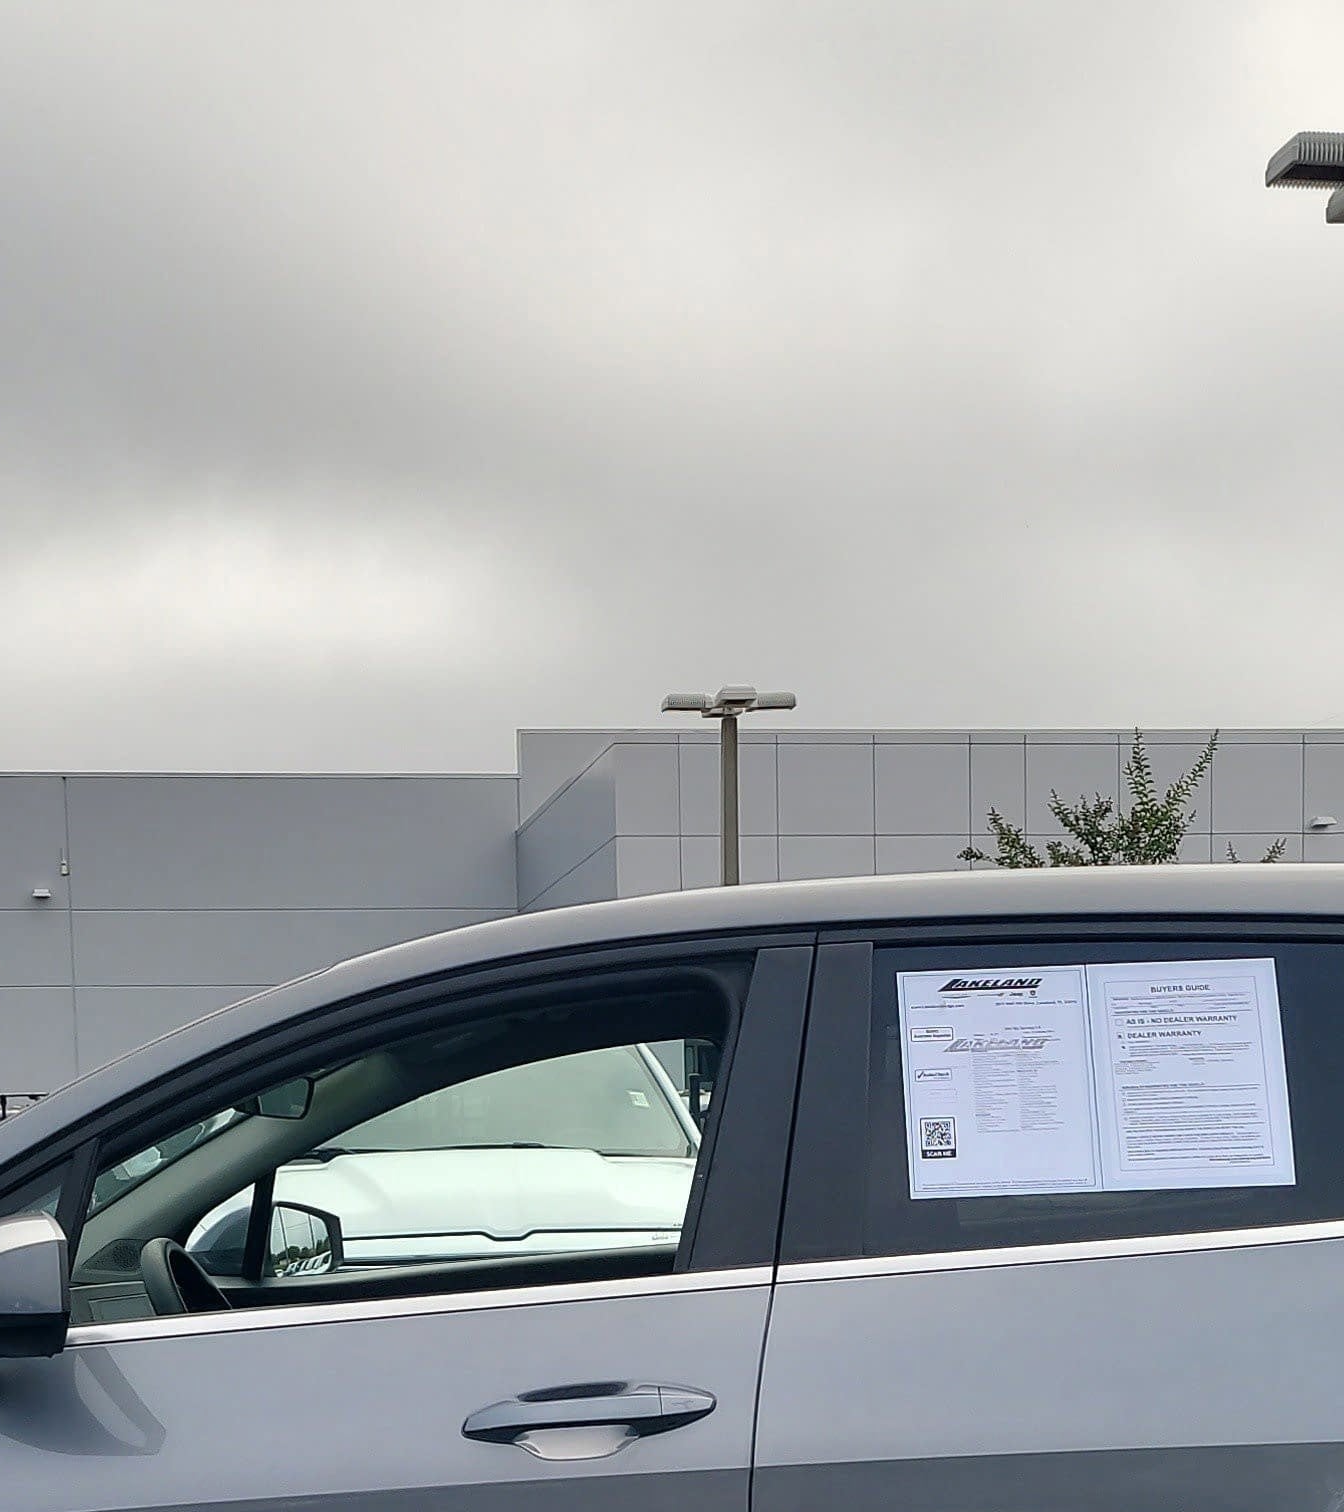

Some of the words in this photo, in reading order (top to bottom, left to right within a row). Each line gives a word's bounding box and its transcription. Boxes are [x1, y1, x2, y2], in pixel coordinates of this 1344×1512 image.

[938, 978, 1043, 992] LAKELAND
[1150, 985, 1183, 993] BUYERS
[1185, 984, 1210, 992] GUIDE
[1150, 1016, 1162, 1024] NO
[1127, 1031, 1157, 1039] DEALER
[1158, 1030, 1202, 1038] WARRANTY
